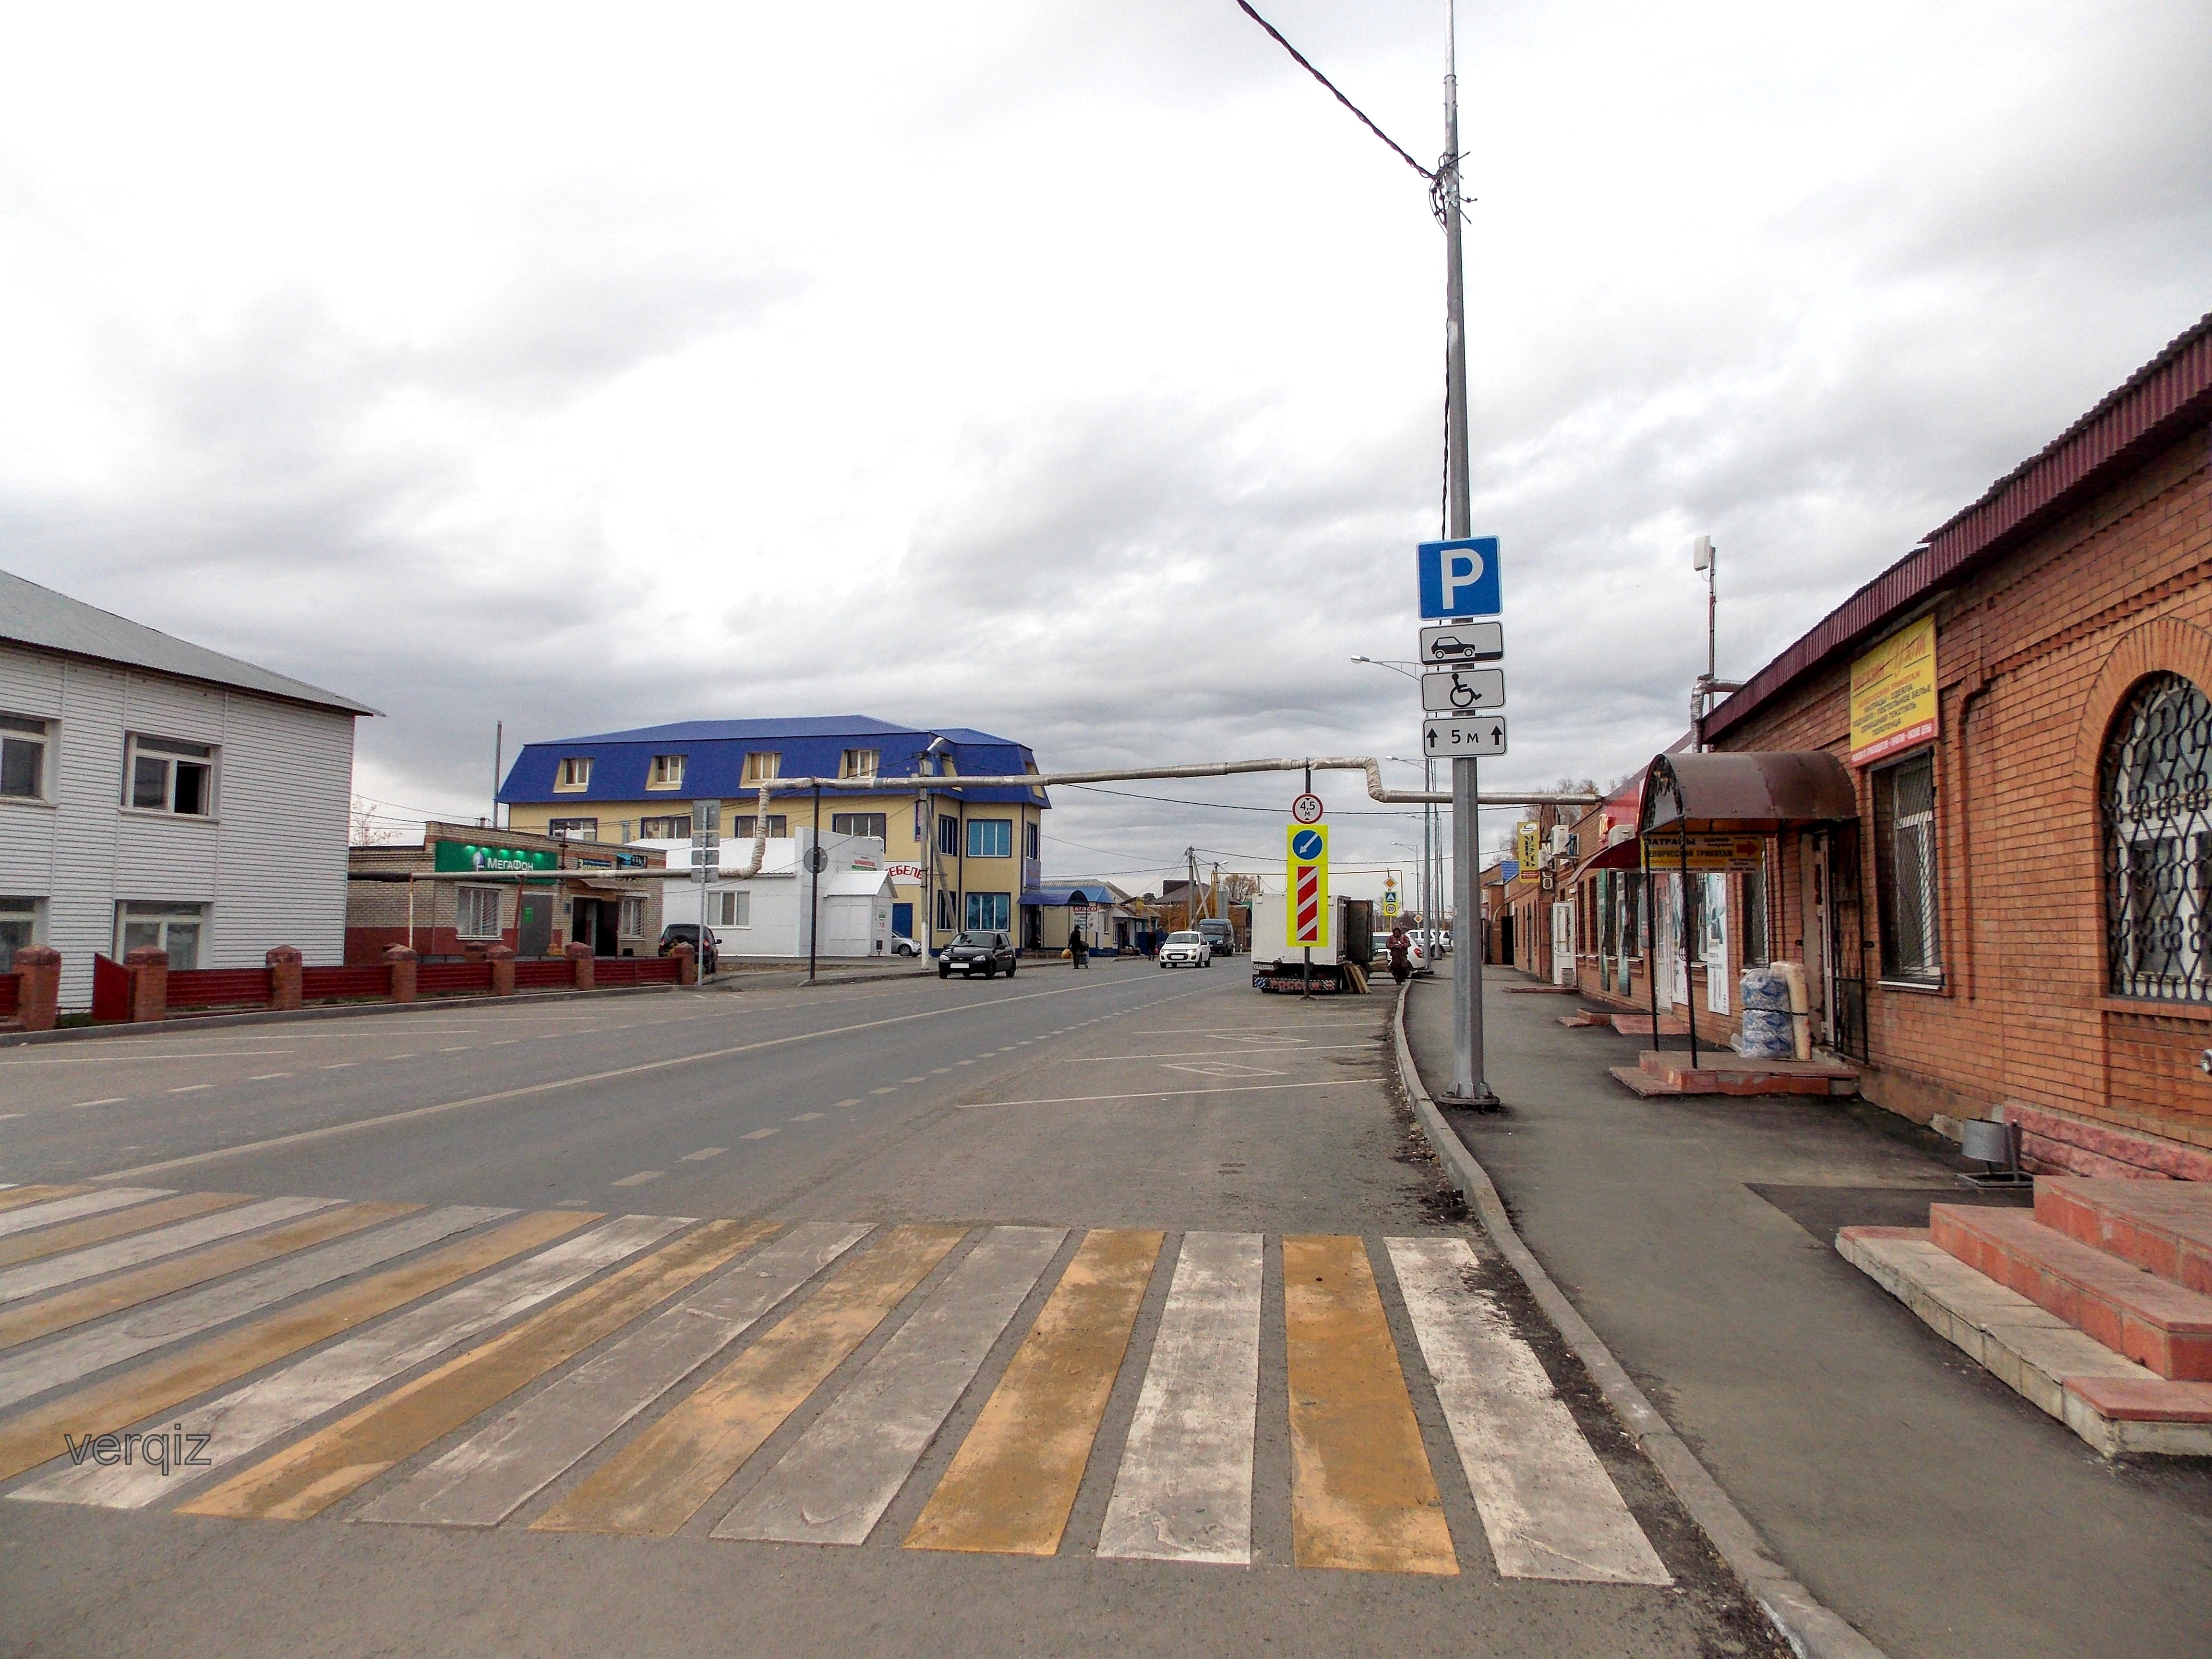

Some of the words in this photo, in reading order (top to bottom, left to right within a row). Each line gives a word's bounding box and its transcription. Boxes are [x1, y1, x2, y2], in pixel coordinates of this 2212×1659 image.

[1440, 548, 1484, 610] P
[1451, 729, 1461, 744] 5
[1300, 801, 1315, 811] 4,5
[886, 865, 922, 880] ЕБЕЛЬ
